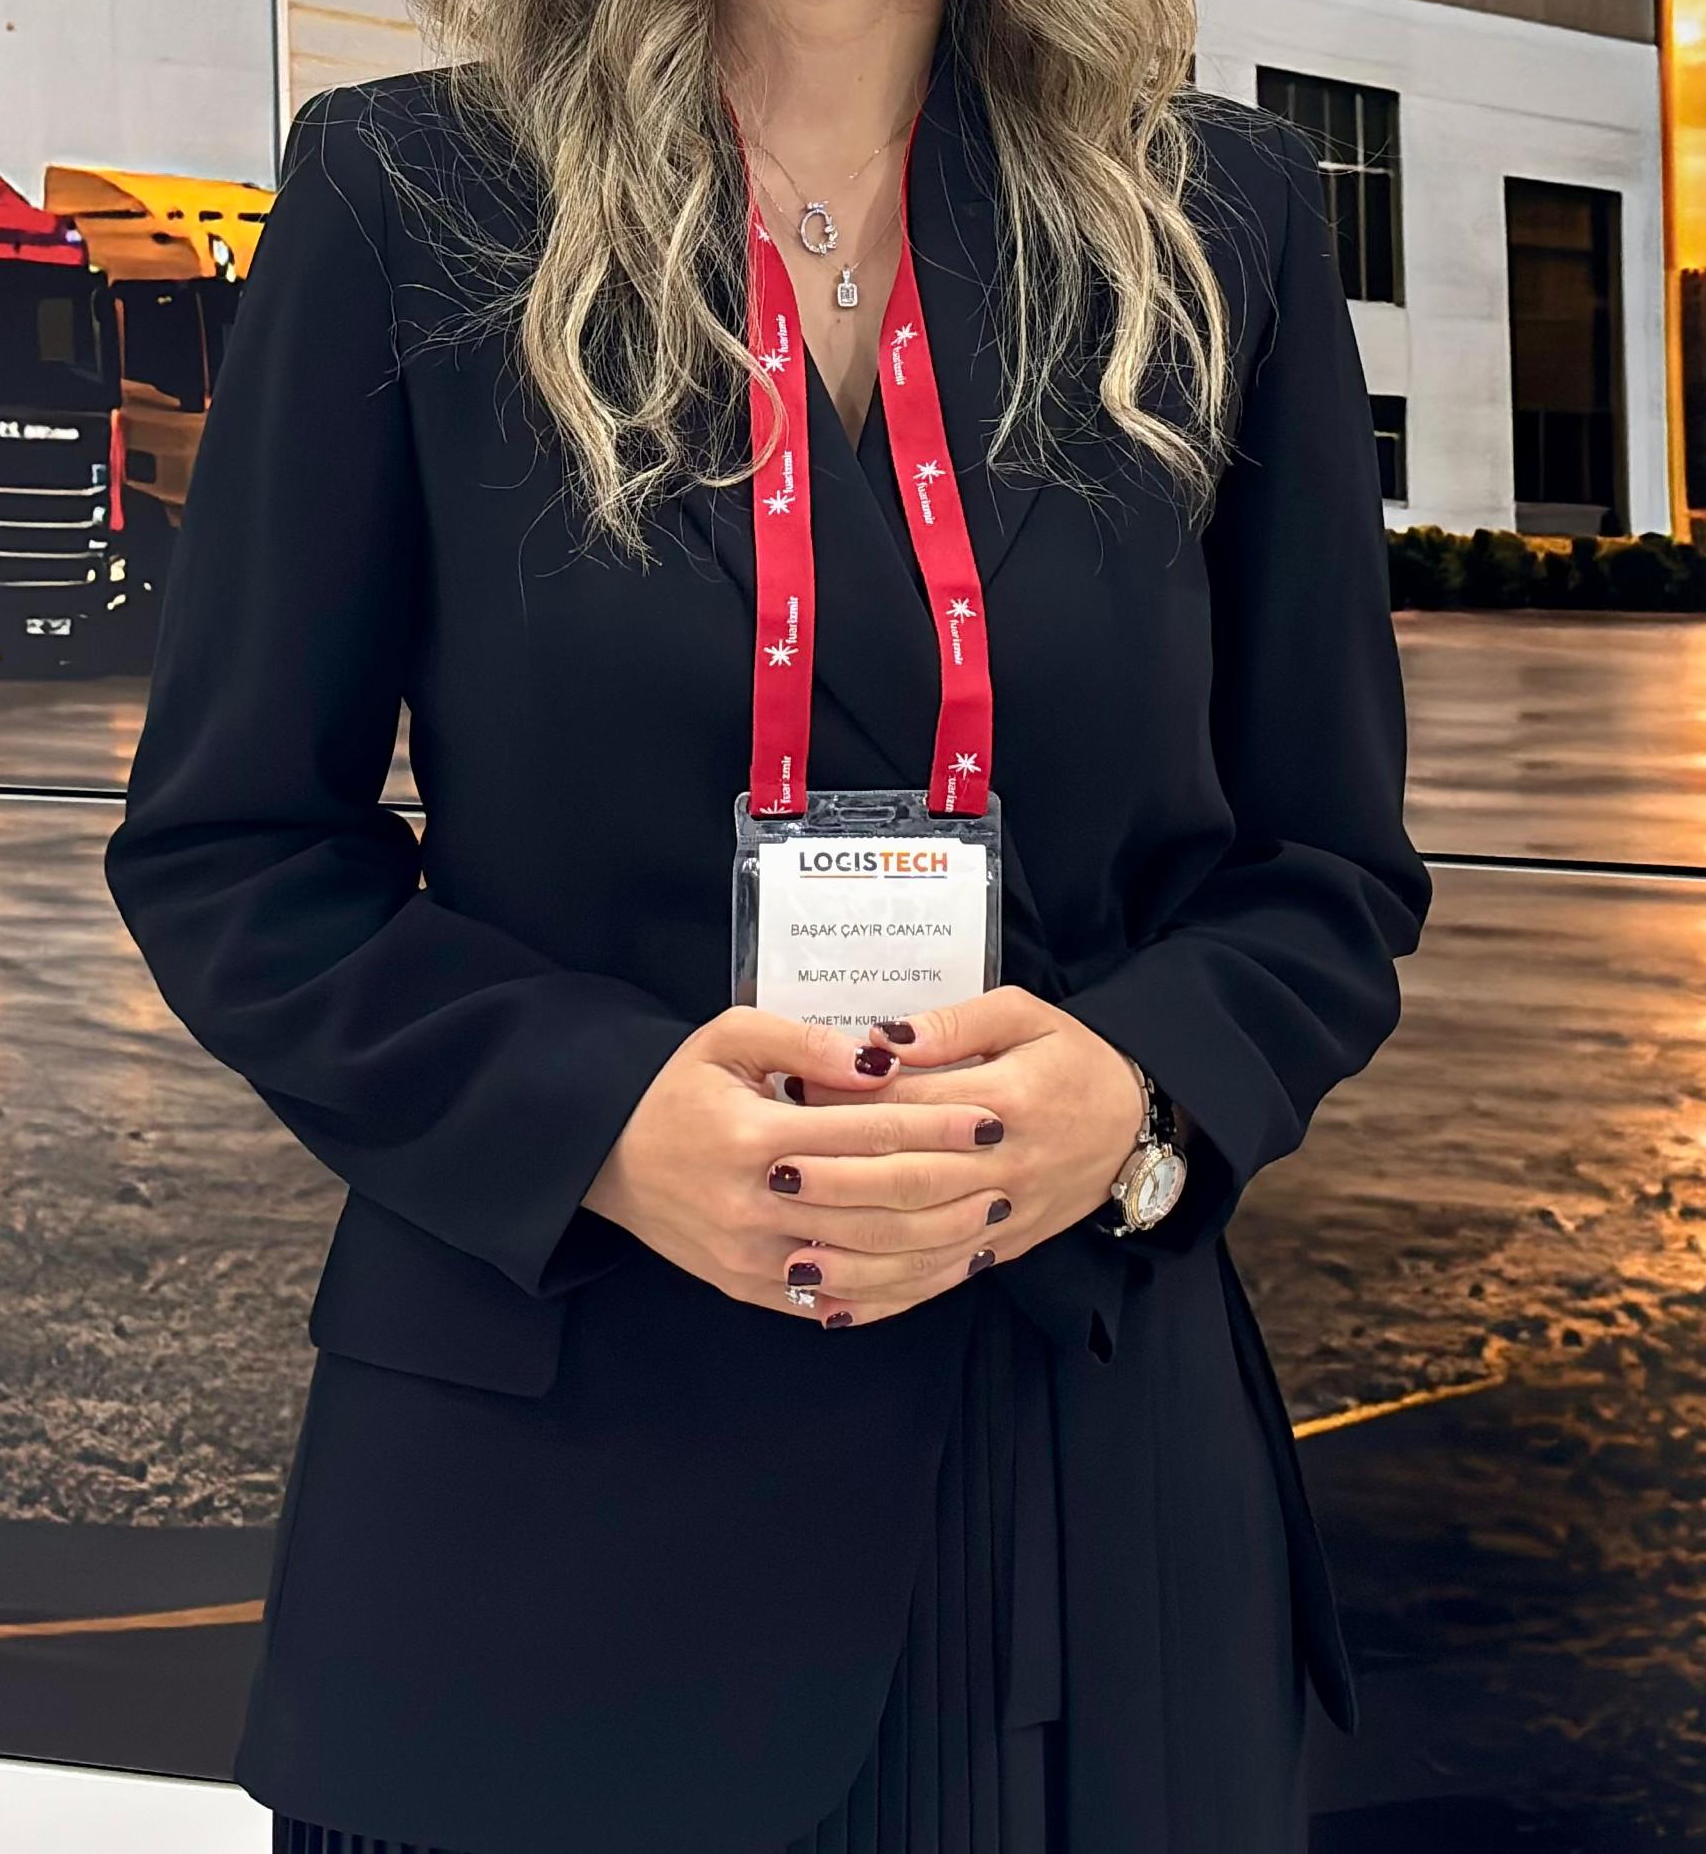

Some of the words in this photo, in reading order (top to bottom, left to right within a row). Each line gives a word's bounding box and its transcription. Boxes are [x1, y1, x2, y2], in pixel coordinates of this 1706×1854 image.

[790, 924, 837, 938] BAŞAK
[841, 924, 882, 938] ÇAYIR
[887, 924, 951, 936] CANATAN
[798, 970, 846, 982] MURAT
[850, 970, 878, 984] ÇAY
[882, 968, 942, 982] LOJİSTİK
